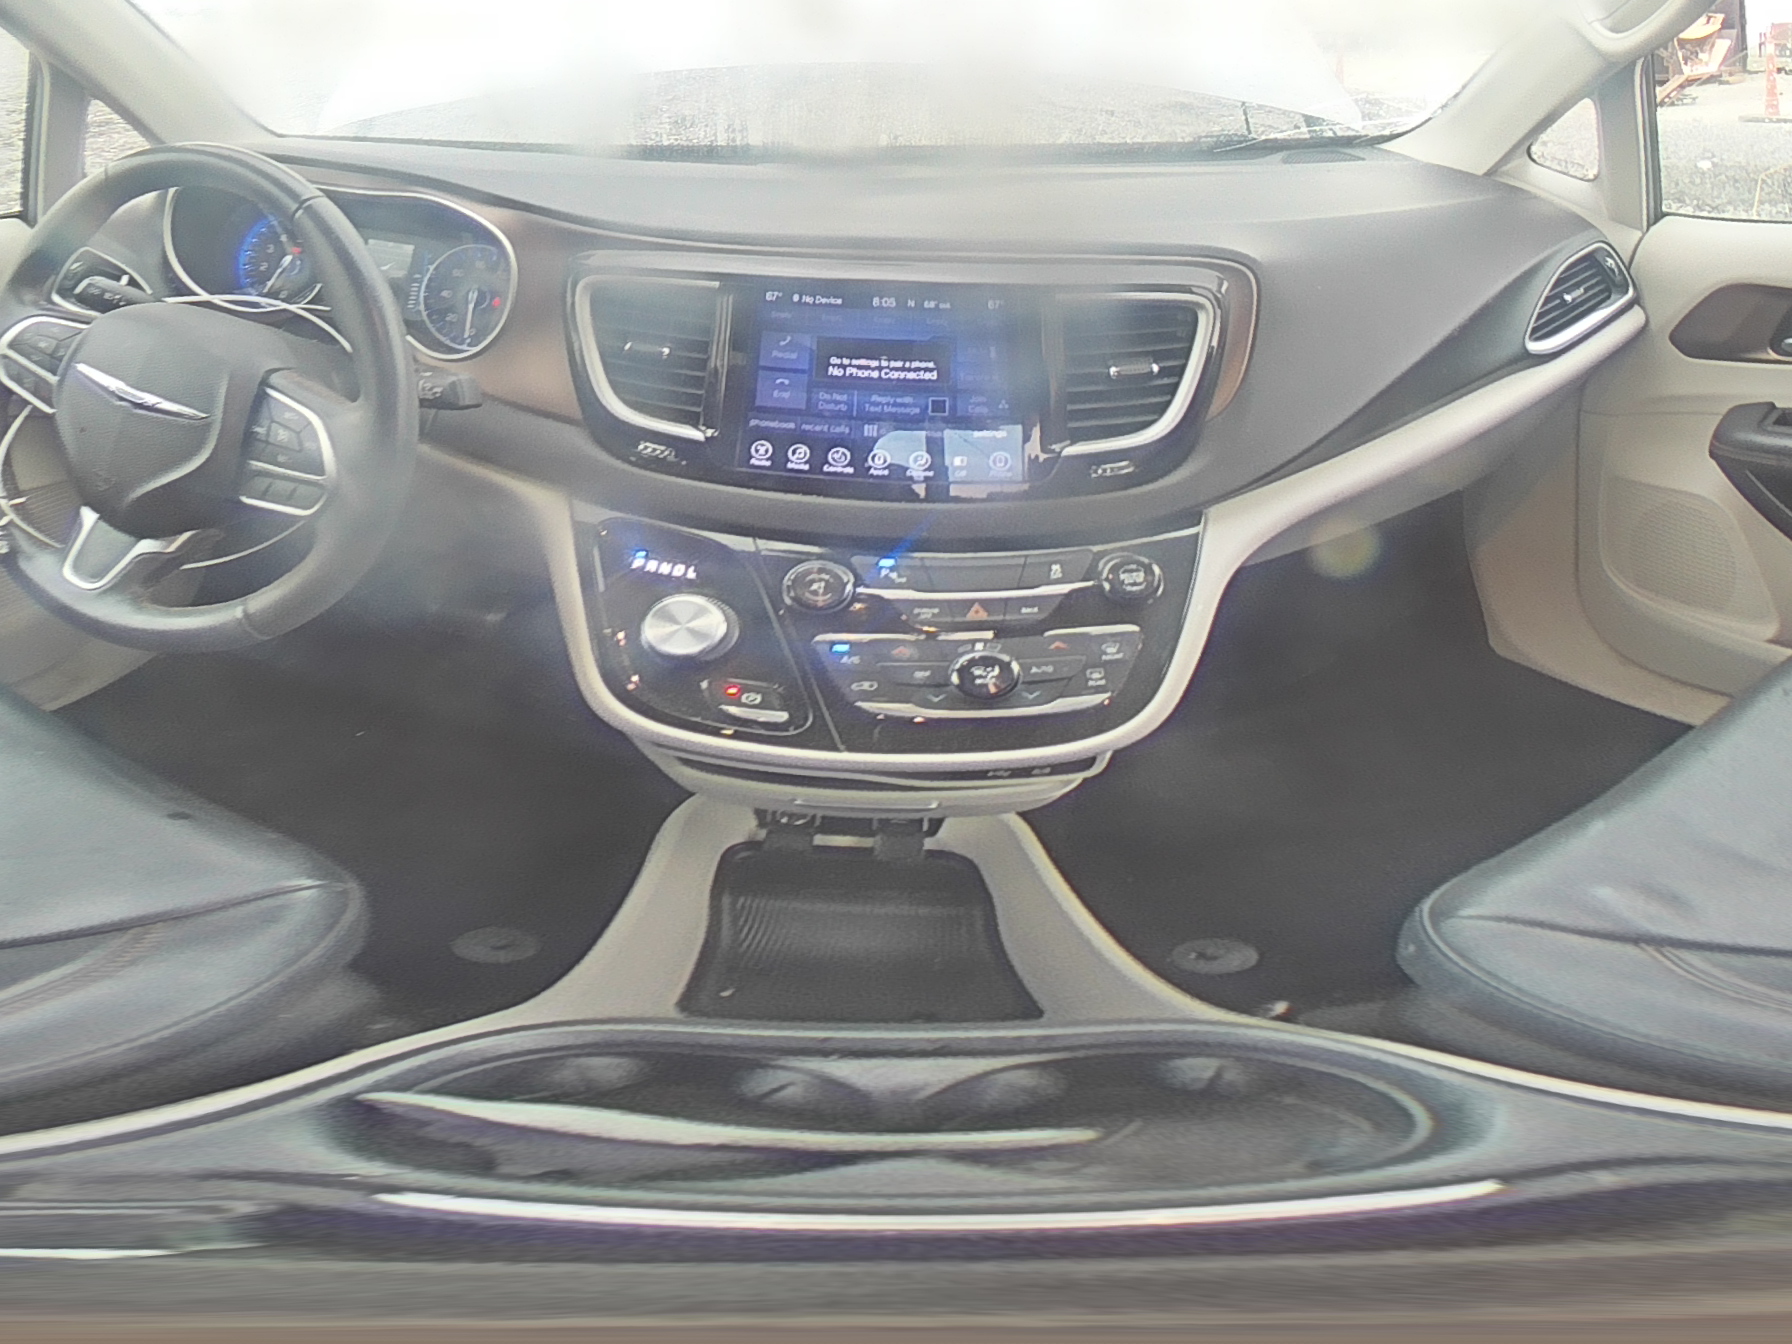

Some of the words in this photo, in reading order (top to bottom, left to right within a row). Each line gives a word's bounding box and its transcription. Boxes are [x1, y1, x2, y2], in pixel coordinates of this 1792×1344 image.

[266, 244, 274, 253] 3
[259, 262, 268, 271] 2
[815, 295, 843, 305] Device
[445, 313, 458, 322] 20
[842, 357, 850, 365] to
[851, 358, 879, 368] settings
[880, 358, 889, 367] to
[889, 360, 903, 369] pair
[827, 366, 844, 377] No
[845, 367, 879, 379] Phone
[881, 369, 937, 380] Connected
[818, 401, 848, 412] Disturb
[883, 404, 921, 415] Message
[801, 422, 828, 433] recent
